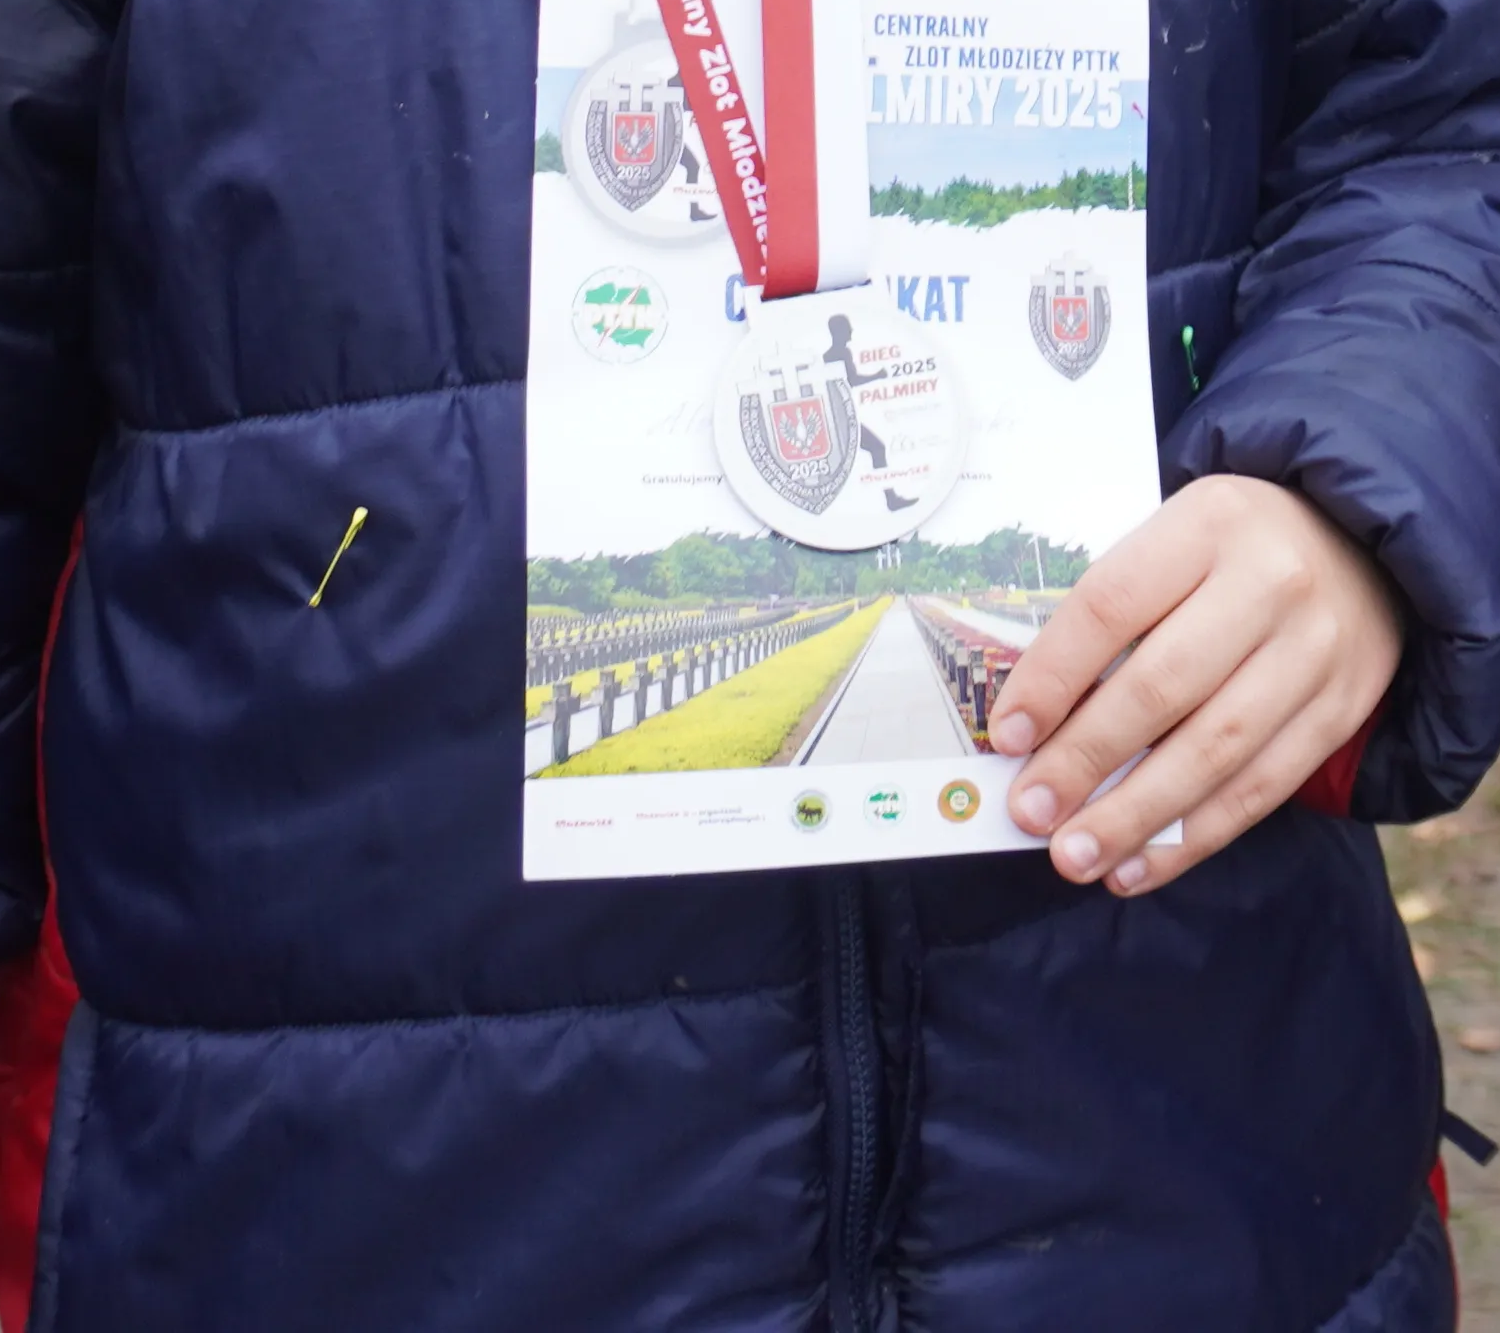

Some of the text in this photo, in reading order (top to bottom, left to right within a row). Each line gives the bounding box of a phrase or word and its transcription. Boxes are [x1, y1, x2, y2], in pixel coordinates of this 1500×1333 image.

[873, 13, 989, 38] CENTRALNY
[905, 43, 1121, 73] ZLOT MŁODZIEŻY PTTK
[699, 43, 739, 112] Zlot
[865, 74, 1124, 130] LMIRY 2025
[616, 165, 651, 181] 2025
[859, 345, 901, 365] BIEG
[891, 358, 937, 378] 2025
[859, 378, 939, 405] PALMIRY
[789, 459, 831, 481] 2025
